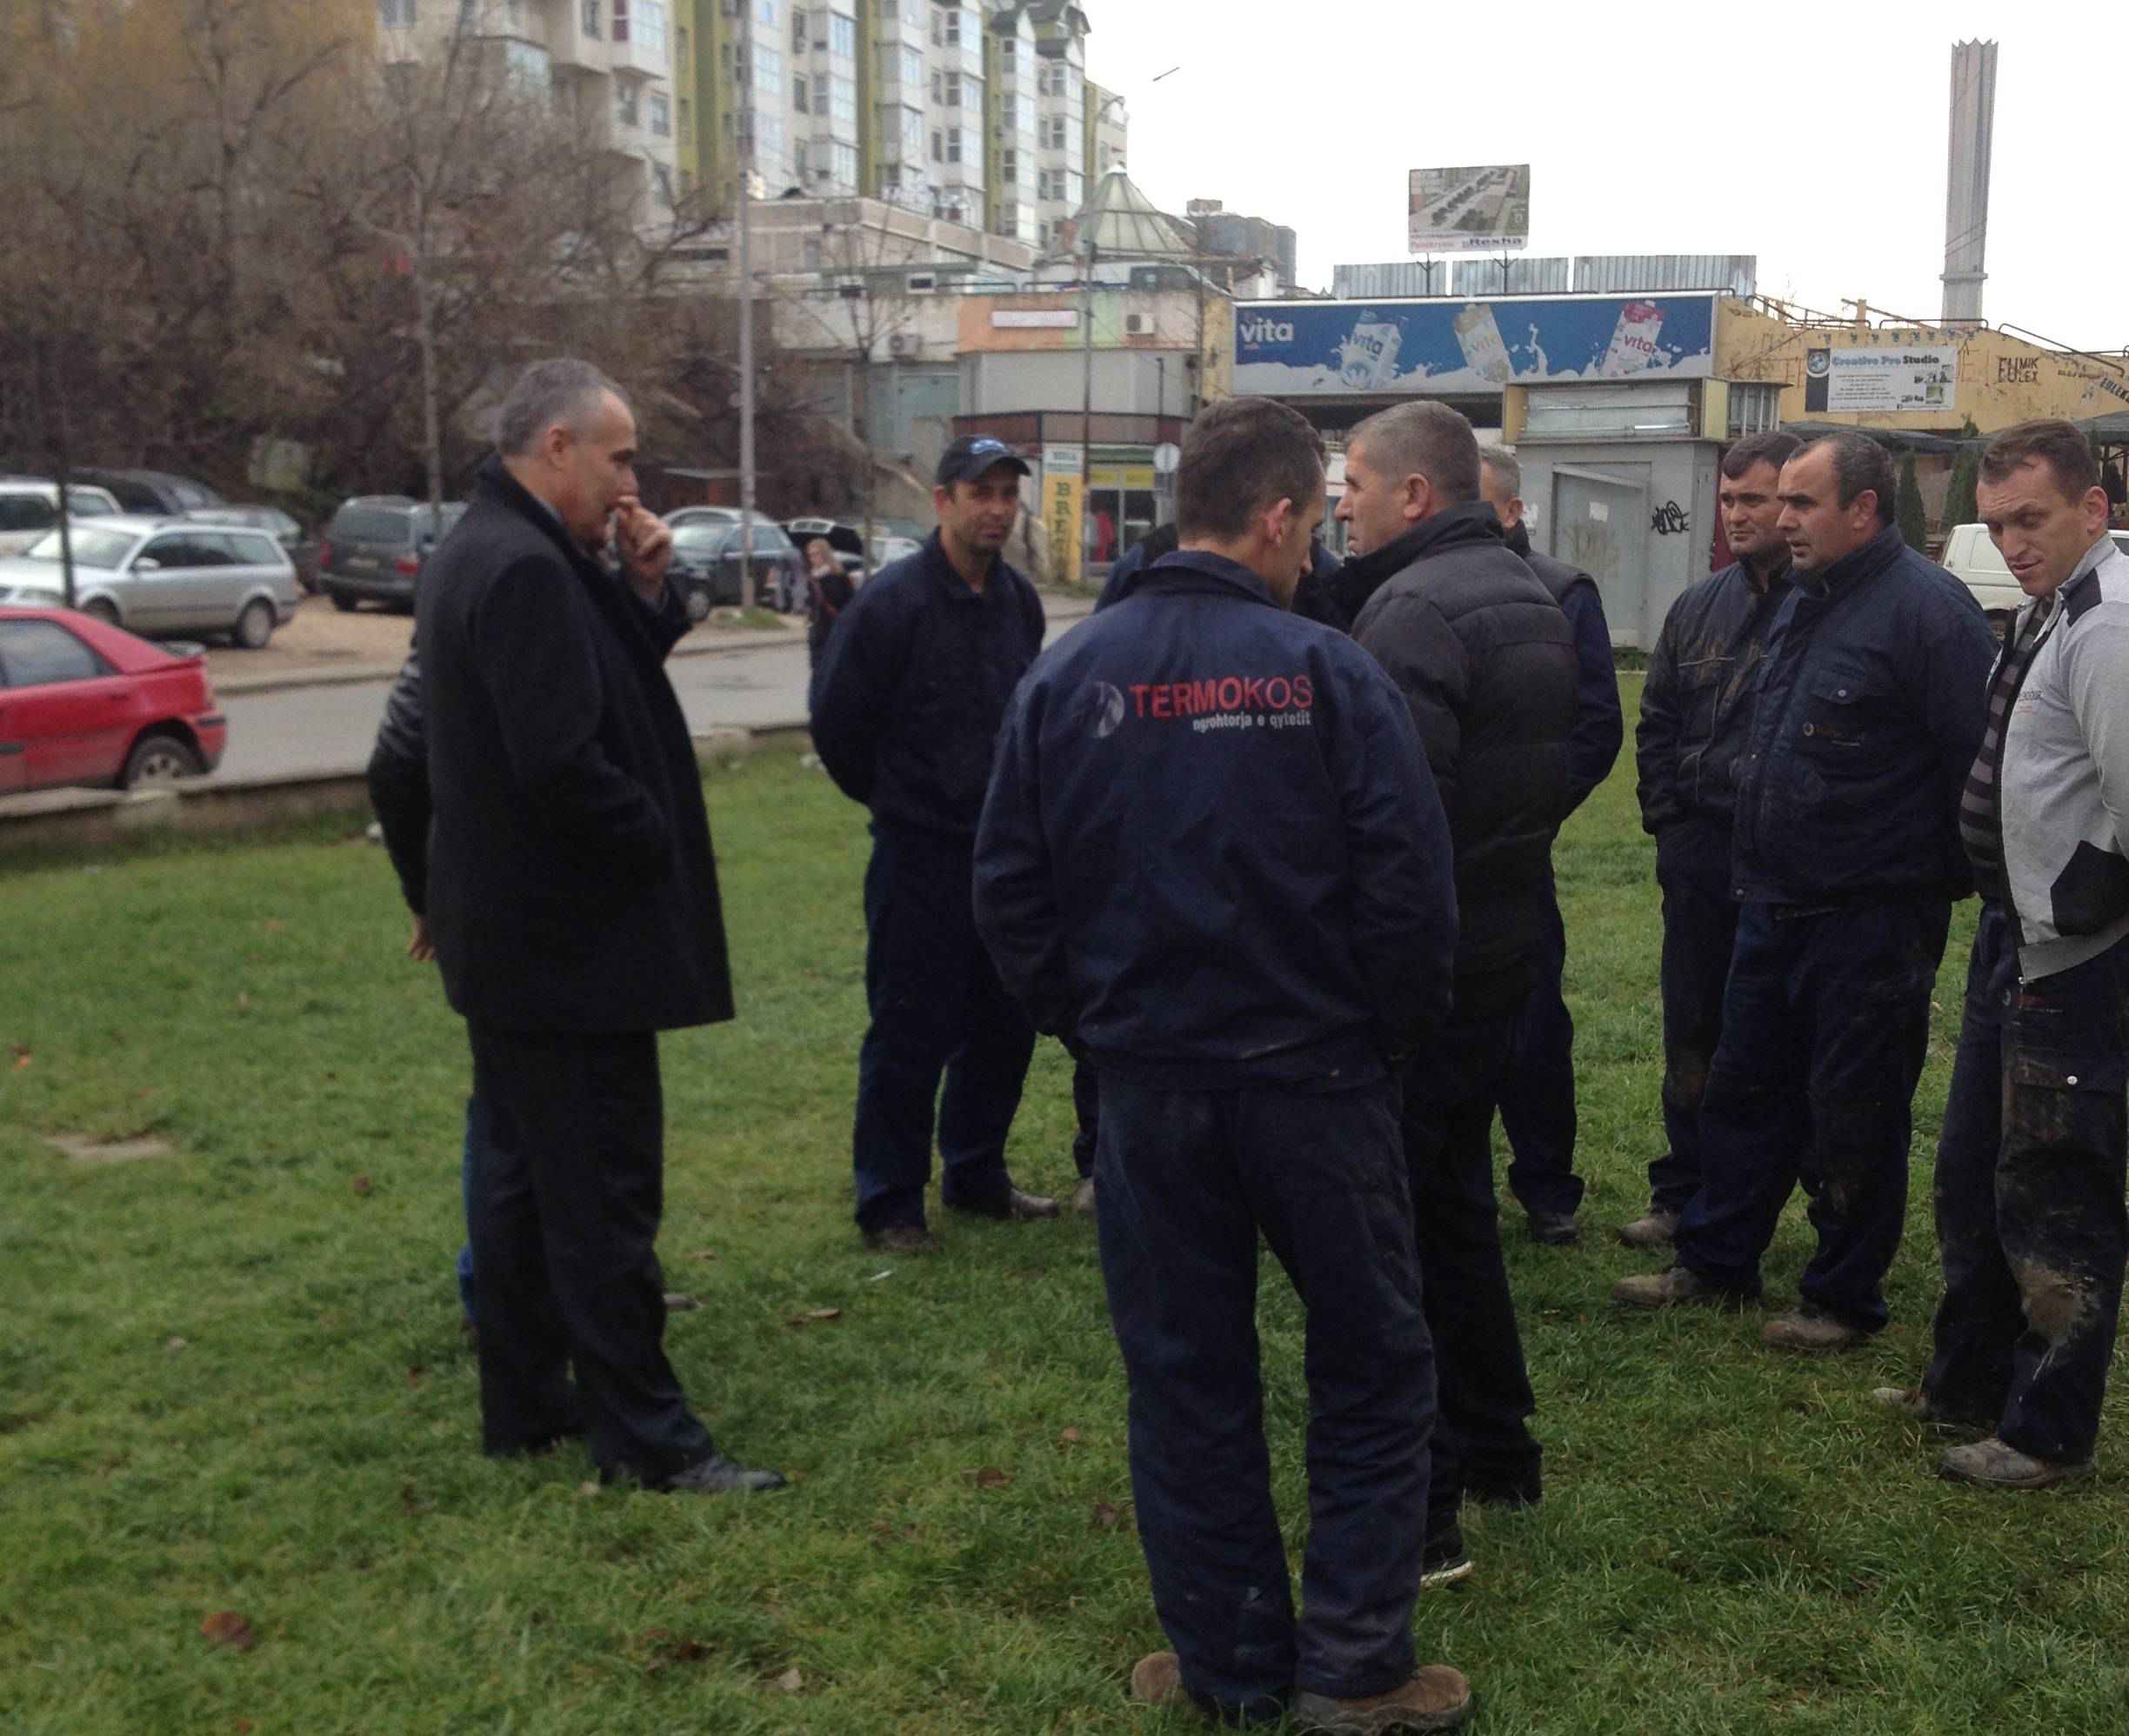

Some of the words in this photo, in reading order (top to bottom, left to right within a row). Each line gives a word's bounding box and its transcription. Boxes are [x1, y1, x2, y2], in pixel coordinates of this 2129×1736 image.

[1239, 317, 1294, 342] vita
[1881, 356, 1901, 365] Pro
[1903, 355, 1939, 364] Studio
[1129, 675, 1313, 718] TERMOKOS
[1258, 713, 1265, 726] e
